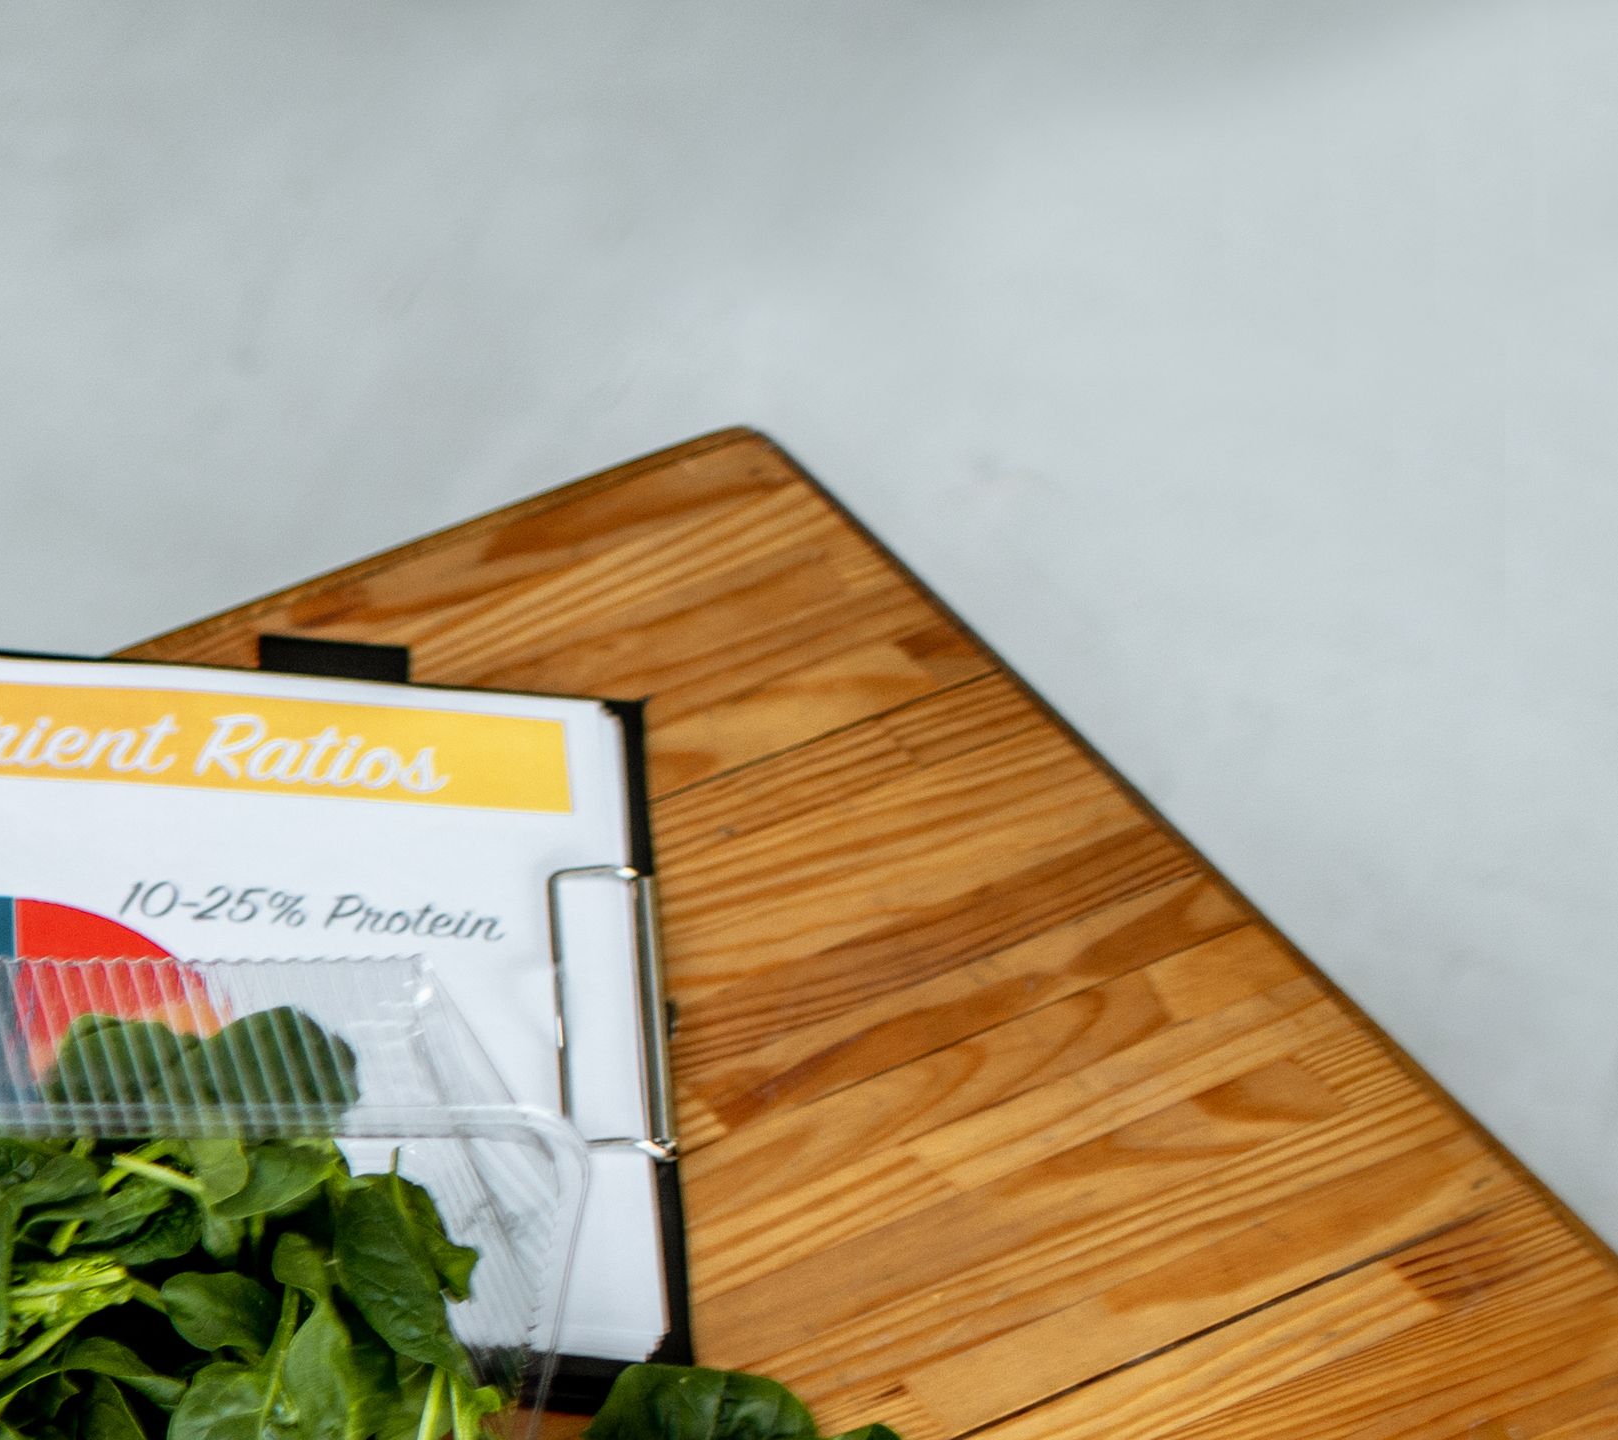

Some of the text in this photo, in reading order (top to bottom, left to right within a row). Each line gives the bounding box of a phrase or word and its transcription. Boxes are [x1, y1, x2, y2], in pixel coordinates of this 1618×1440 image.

[193, 713, 449, 793] Ratios
[119, 881, 503, 940] 10-25% Protein
